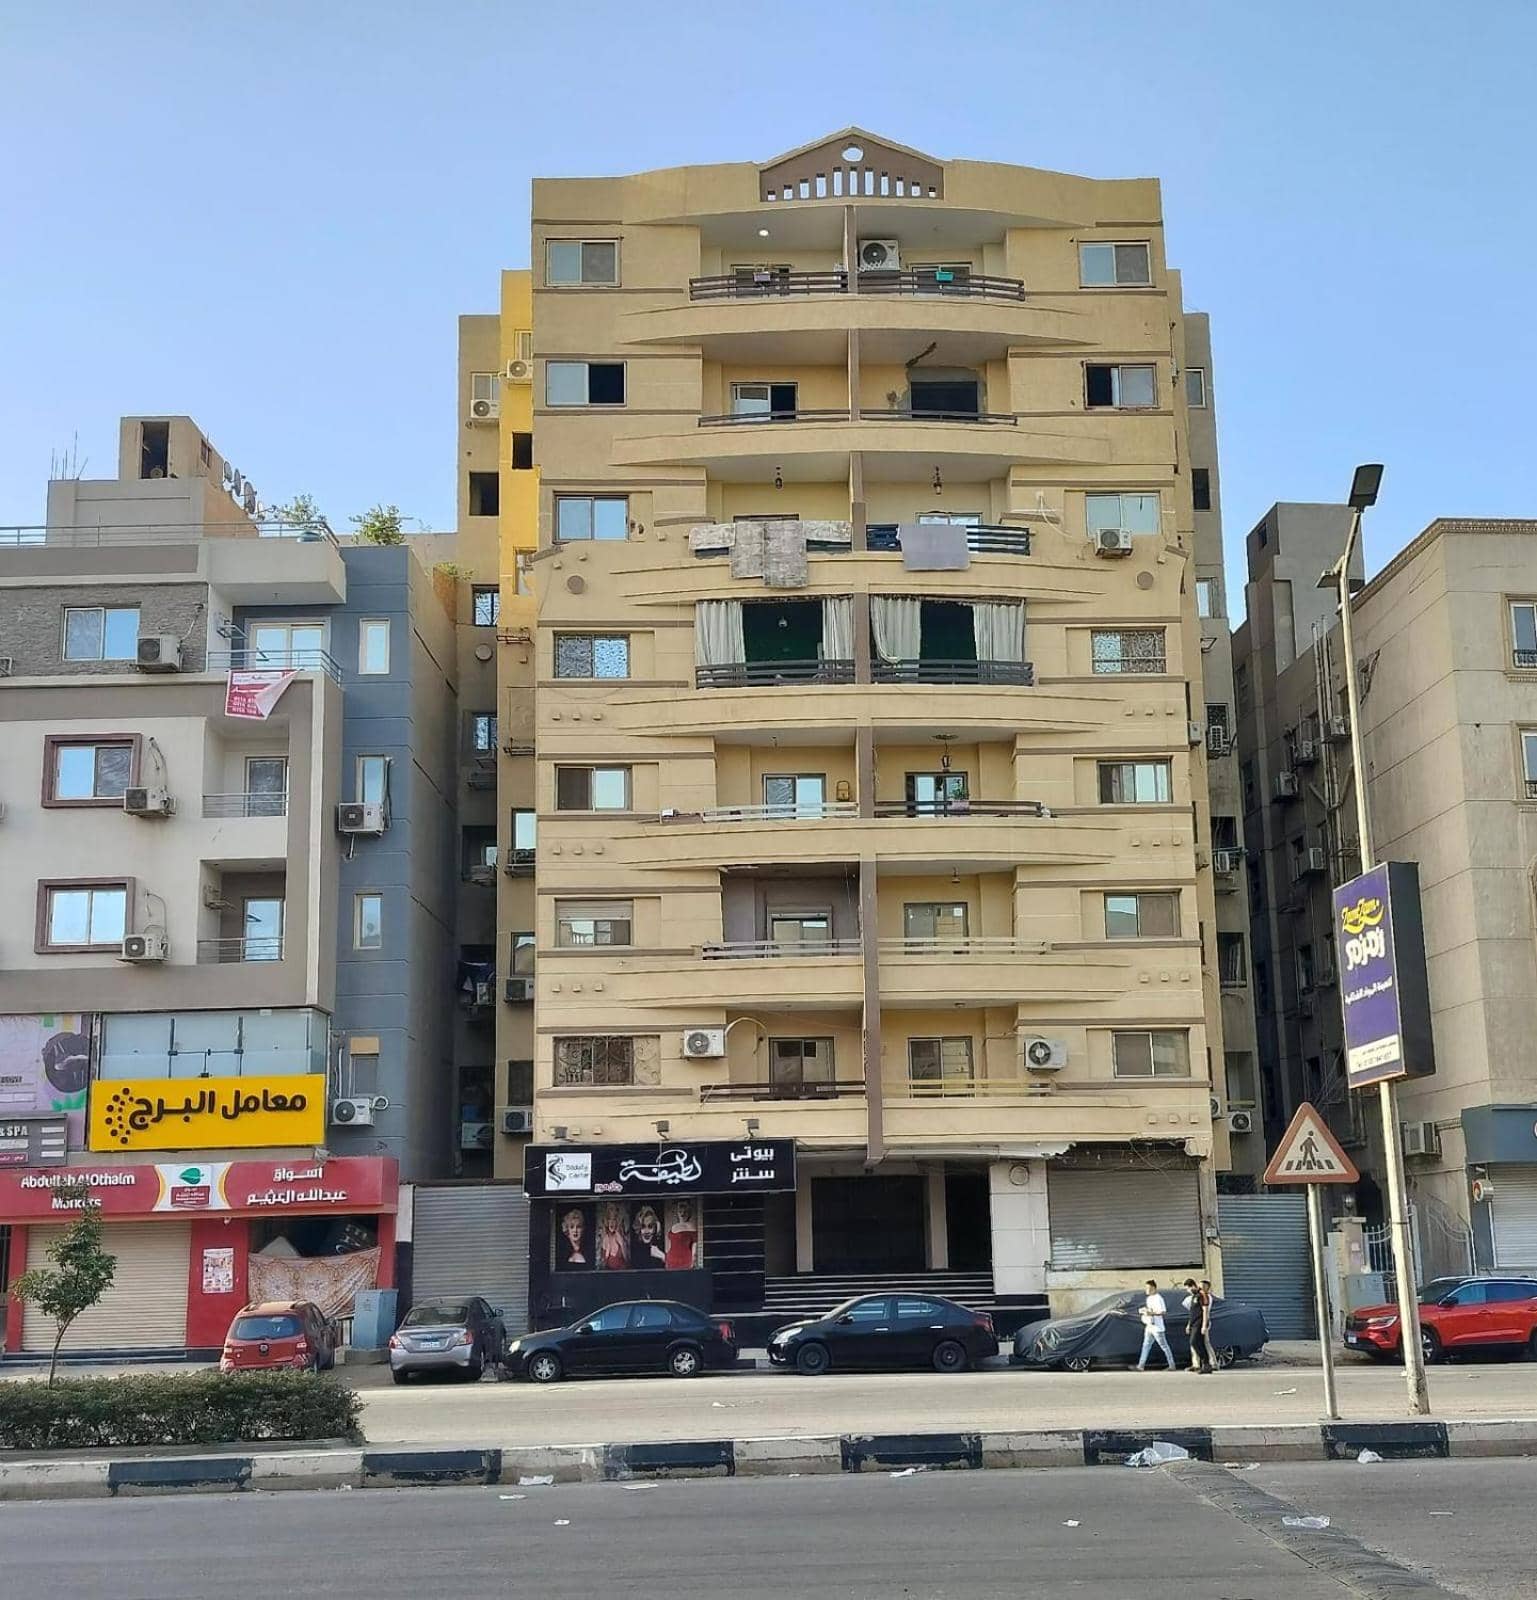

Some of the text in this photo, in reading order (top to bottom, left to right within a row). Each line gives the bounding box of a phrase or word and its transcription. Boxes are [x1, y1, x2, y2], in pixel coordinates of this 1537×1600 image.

[129, 1089, 307, 1130] معامل البرج
[6, 1125, 28, 1137] SPA
[619, 1147, 702, 1184] لطيفة
[731, 1167, 775, 1183] سنتر
[246, 1189, 295, 1205] العثيم
